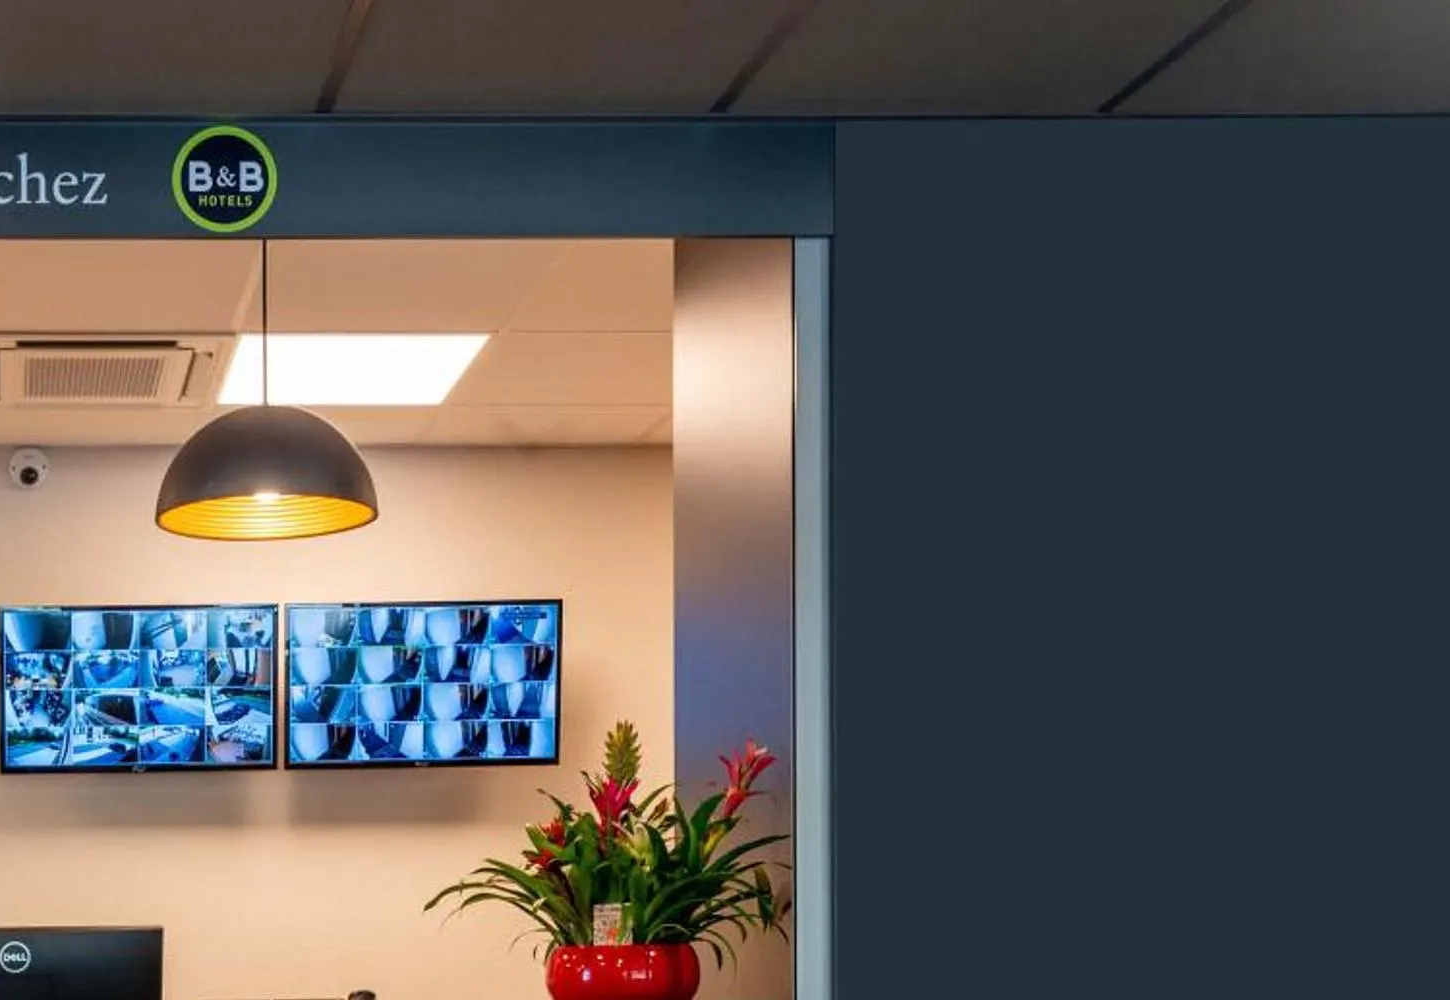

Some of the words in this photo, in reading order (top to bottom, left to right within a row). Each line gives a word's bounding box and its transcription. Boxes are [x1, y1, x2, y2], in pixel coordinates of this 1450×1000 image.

[188, 160, 264, 192] B&B
[198, 194, 253, 207] HOTELS
[3, 952, 28, 962] DELL
